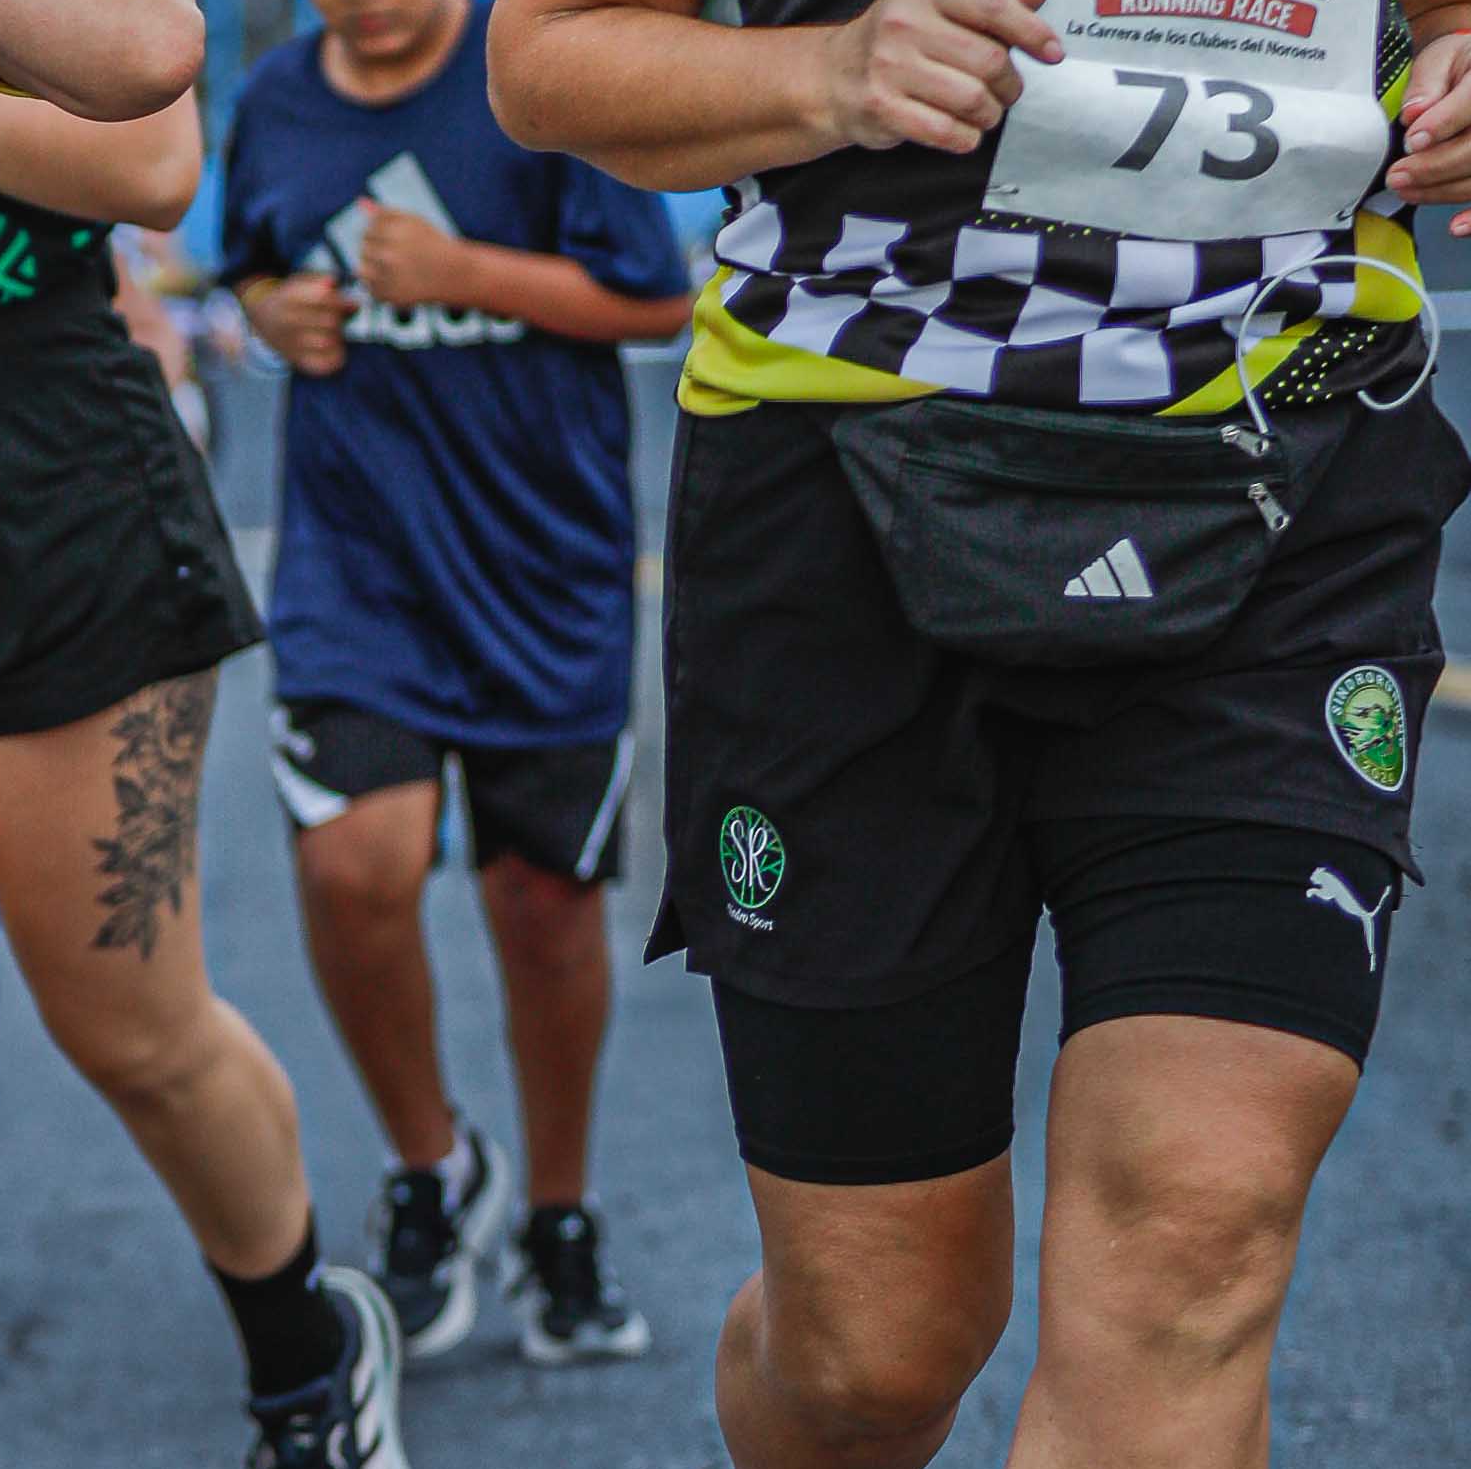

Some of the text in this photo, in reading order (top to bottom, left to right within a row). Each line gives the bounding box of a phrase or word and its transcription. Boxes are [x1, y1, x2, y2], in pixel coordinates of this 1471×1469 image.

[1065, 19, 1083, 36] La
[1086, 21, 1141, 42] Carrera
[1143, 28, 1162, 44] de
[1164, 29, 1187, 46] los
[1188, 30, 1238, 51] Clubes
[1239, 37, 1265, 53] del
[1110, 67, 1281, 181] 73
